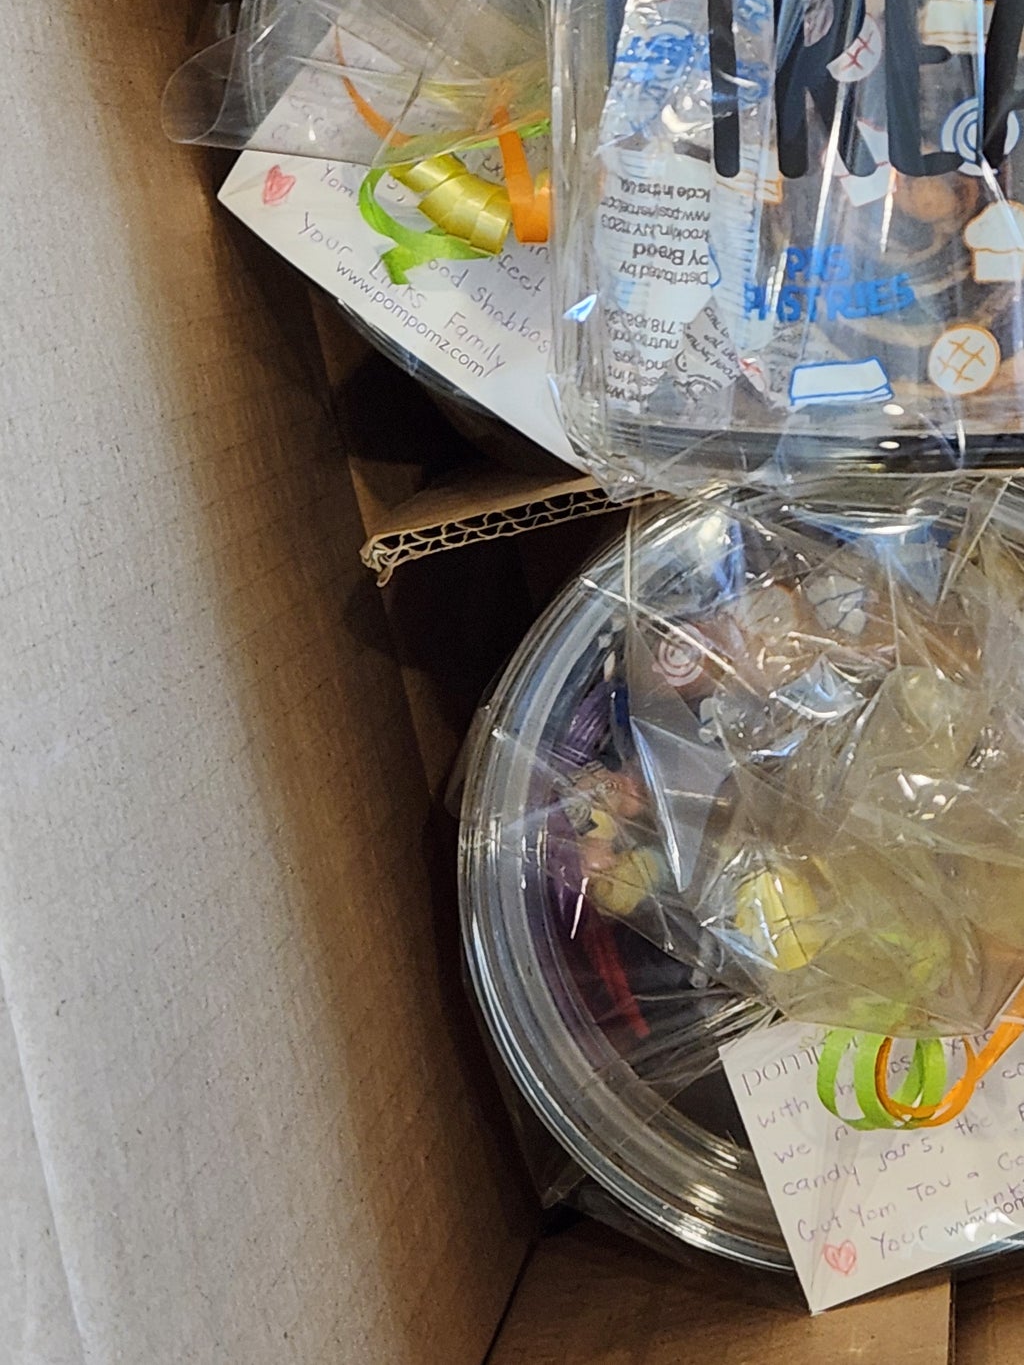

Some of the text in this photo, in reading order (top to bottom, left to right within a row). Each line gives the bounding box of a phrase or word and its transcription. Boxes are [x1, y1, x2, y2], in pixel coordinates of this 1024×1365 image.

[631, 242, 684, 265] Bread
[292, 210, 357, 265] Your
[431, 308, 515, 385] Family
[328, 259, 491, 379] www.pompomz.com
[753, 1091, 813, 1131] with
[778, 1155, 863, 1208] candy
[951, 1108, 995, 1139] the
[847, 1192, 900, 1231] Yom
[868, 1217, 935, 1262] Your
